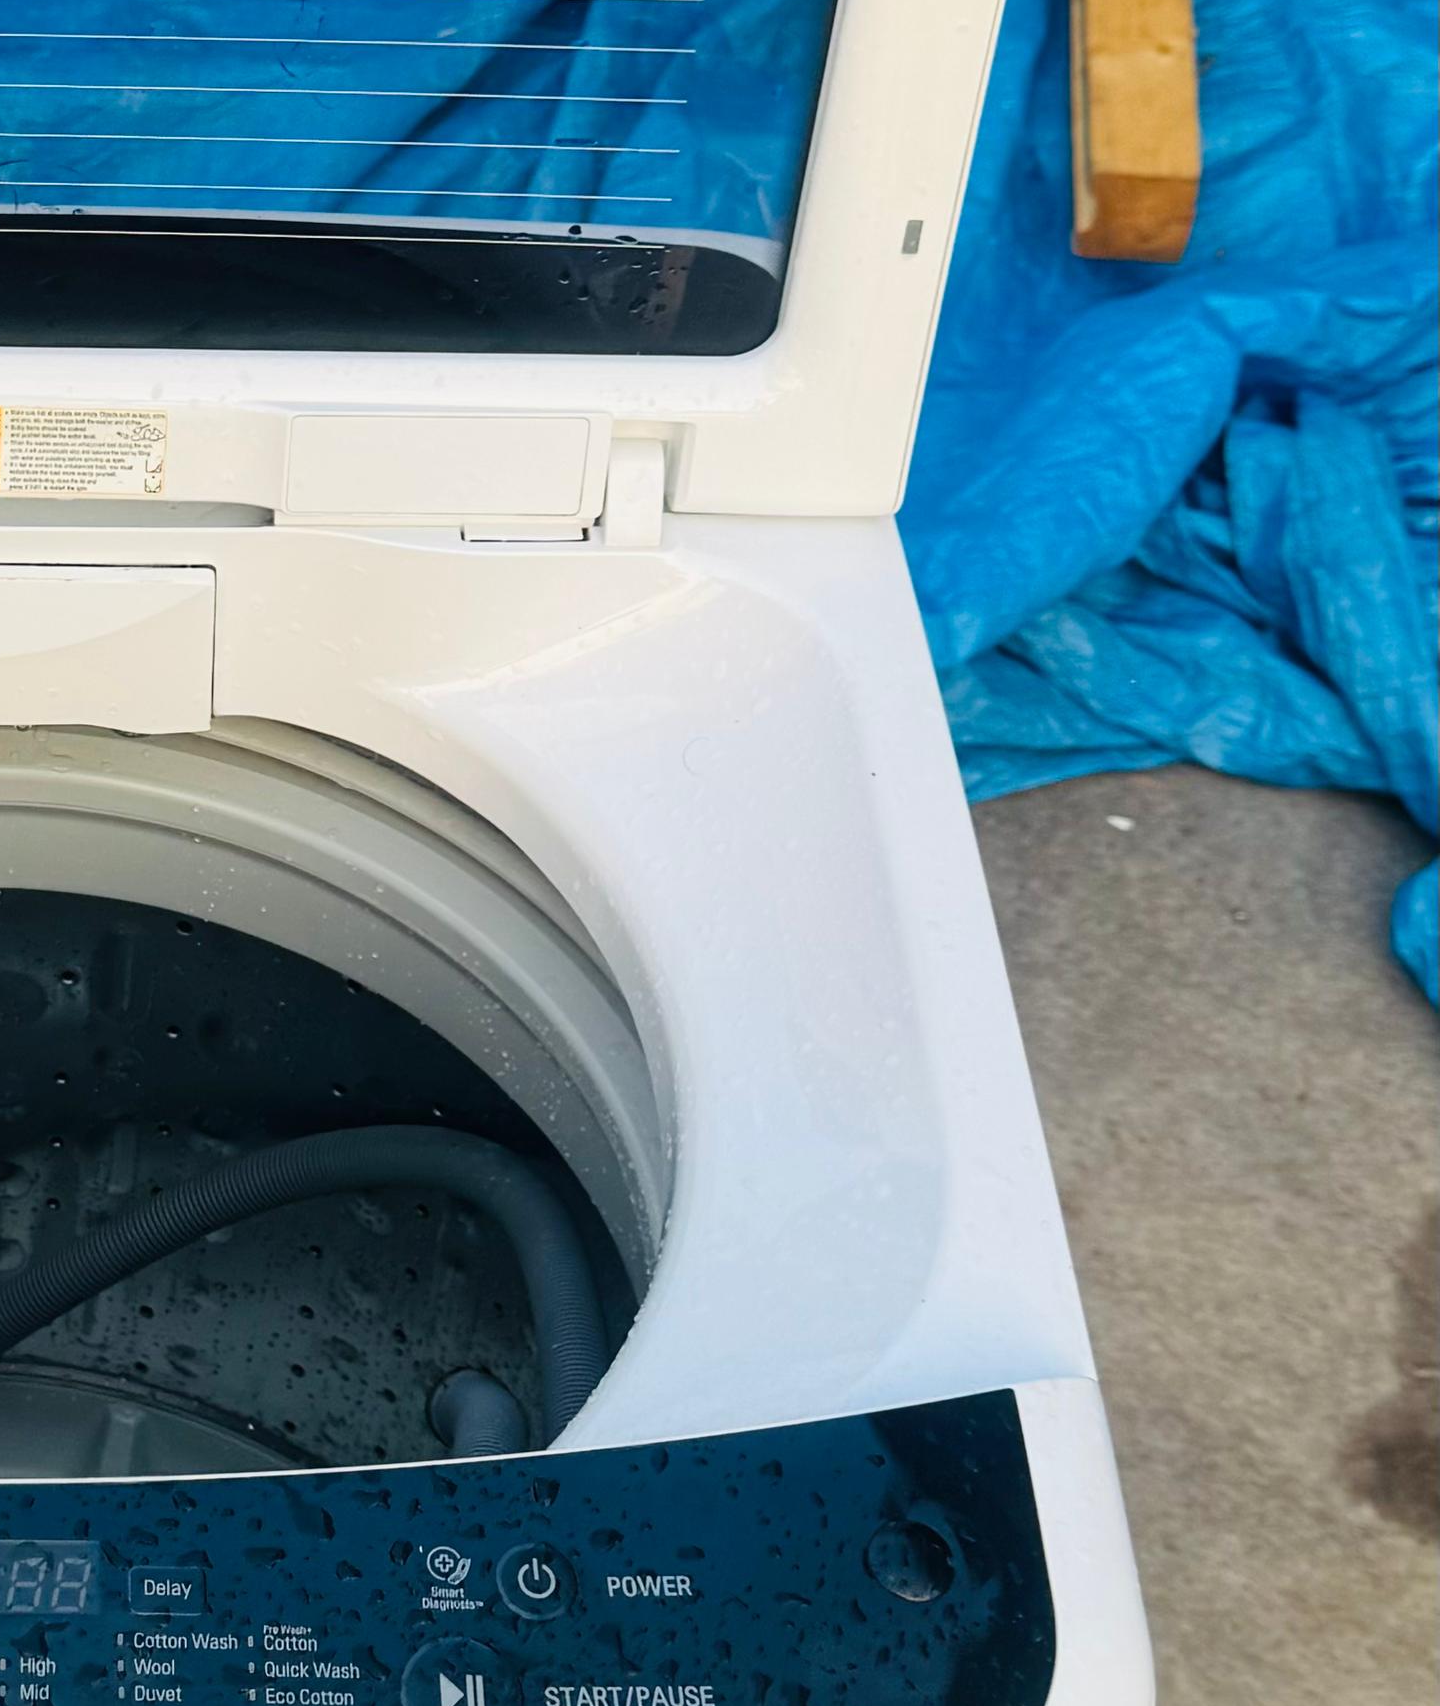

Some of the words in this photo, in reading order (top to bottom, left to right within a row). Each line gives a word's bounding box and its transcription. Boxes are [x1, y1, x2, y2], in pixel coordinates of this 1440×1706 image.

[143, 1579, 193, 1600] Delay
[606, 1574, 693, 1598] POWER
[133, 1633, 190, 1650] Cotton
[192, 1633, 239, 1651] Wash
[263, 1634, 318, 1652] Cotton
[19, 1658, 57, 1676] High
[133, 1659, 176, 1677] Wool
[264, 1661, 310, 1678] Quick
[312, 1662, 361, 1679] Wash
[19, 1684, 50, 1701] Mid
[133, 1686, 183, 1704] Duvet
[265, 1688, 296, 1705] Eco
[300, 1688, 355, 1706] Cotton
